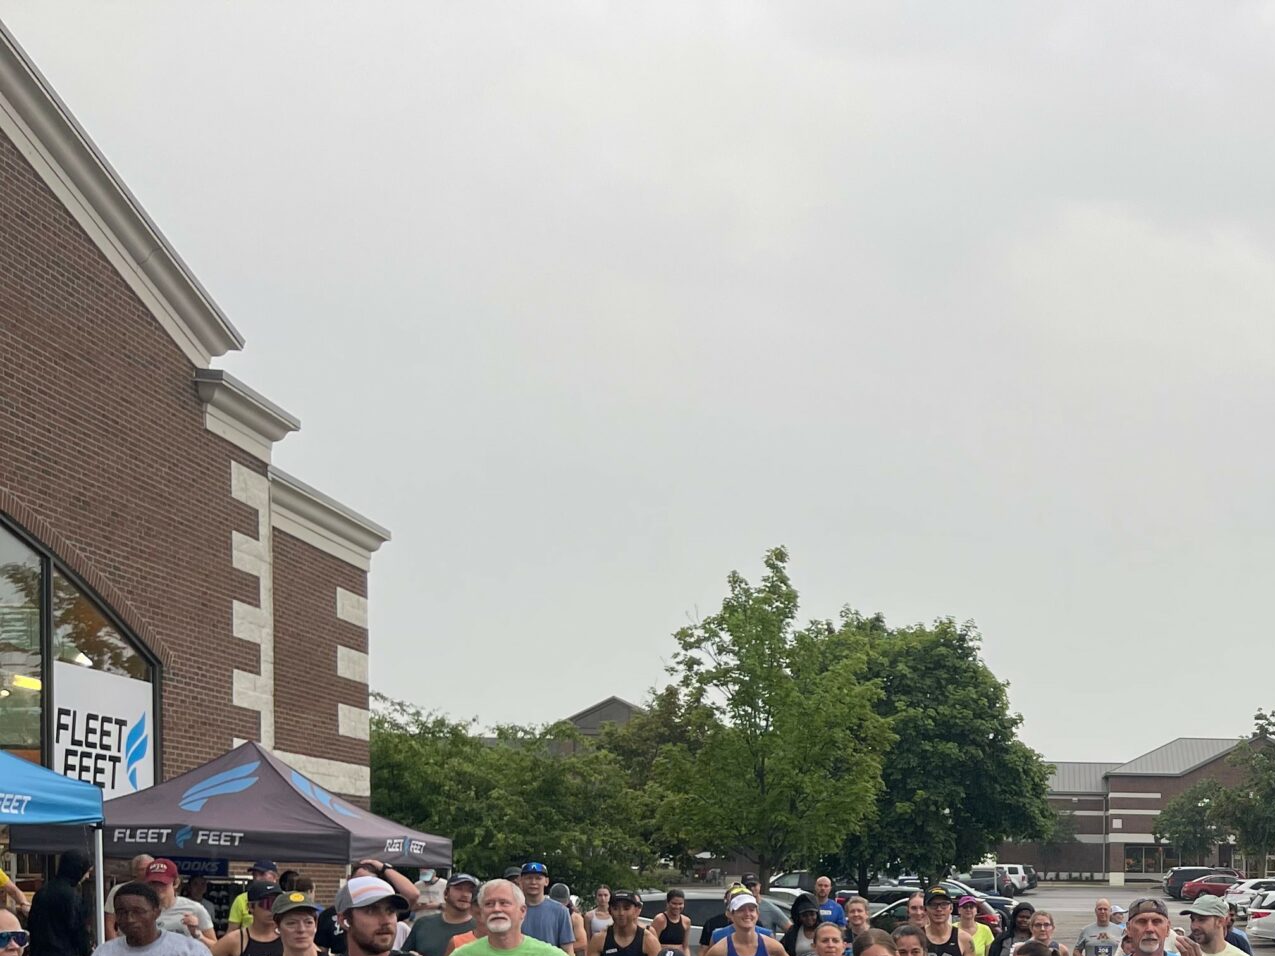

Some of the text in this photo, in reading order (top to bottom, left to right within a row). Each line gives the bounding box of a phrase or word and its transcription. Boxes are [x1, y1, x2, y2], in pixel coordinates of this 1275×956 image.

[56, 707, 128, 753] FLEET
[63, 748, 122, 790] FEET
[113, 828, 244, 846] FLEET FEET
[384, 839, 426, 854] FLEET FEET
